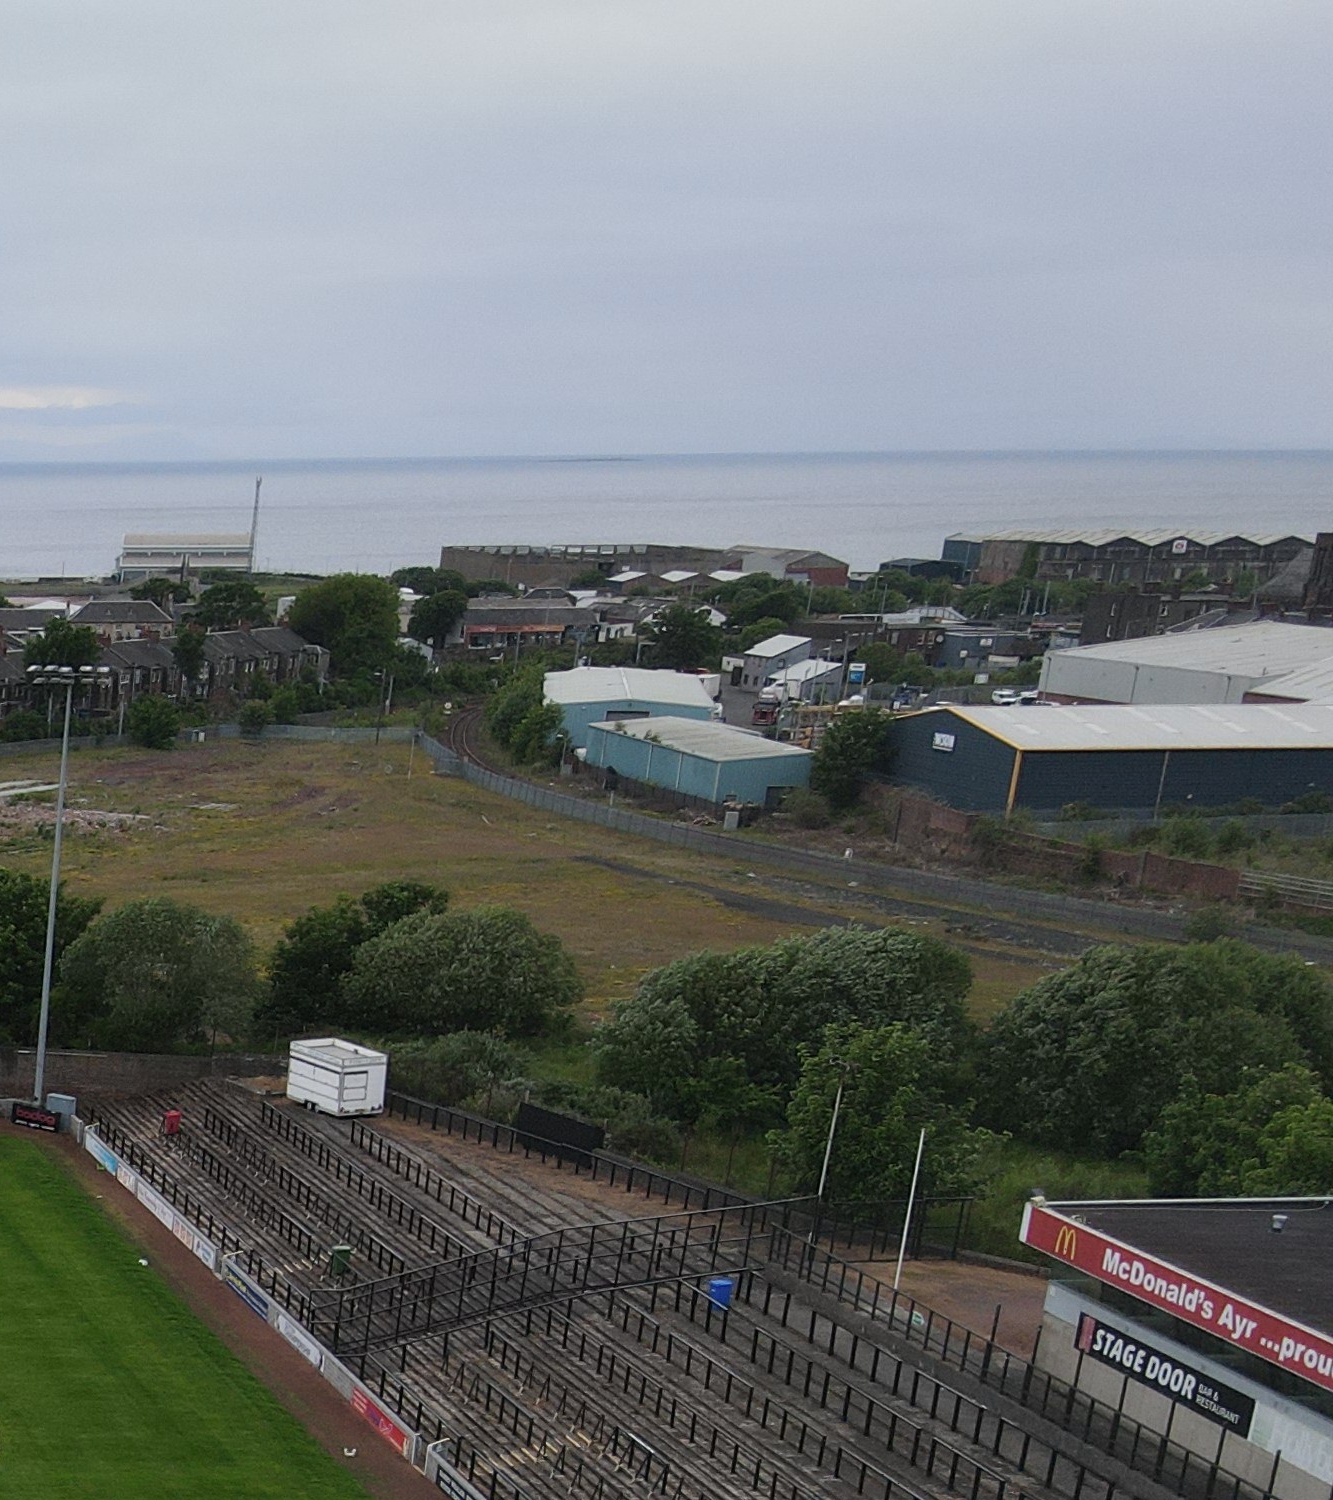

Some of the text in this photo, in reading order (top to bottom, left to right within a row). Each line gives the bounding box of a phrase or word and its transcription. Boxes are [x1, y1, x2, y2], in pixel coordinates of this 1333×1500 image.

[1101, 1248, 1333, 1378] McDonald's Ayr ...prou
[1091, 1328, 1197, 1400] STAGE DOOR
[1195, 1394, 1241, 1426] RESTAURANT
